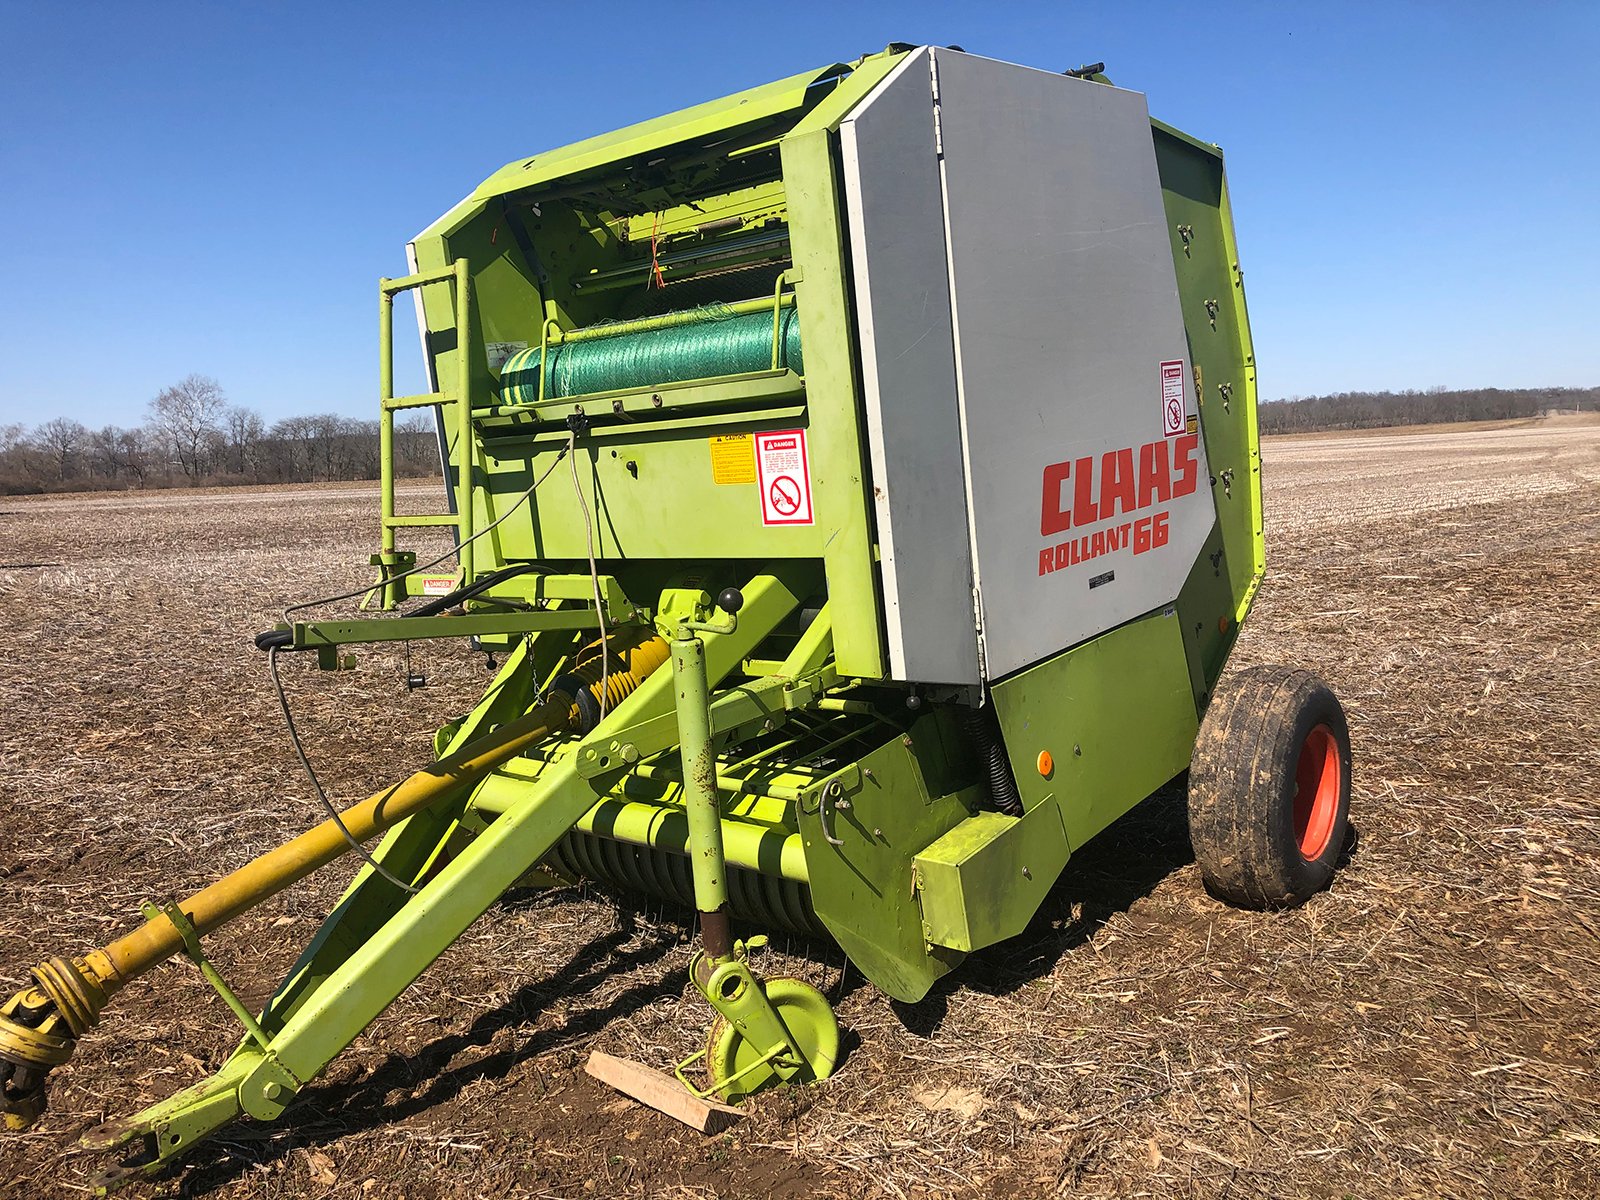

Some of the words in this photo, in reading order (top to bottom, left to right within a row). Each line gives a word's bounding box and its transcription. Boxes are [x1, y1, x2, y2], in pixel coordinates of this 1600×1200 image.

[773, 440, 794, 448] DANGER
[1041, 434, 1198, 537] CLAAS
[1039, 522, 1131, 576] ROLLANT
[1133, 511, 1169, 555] 66
